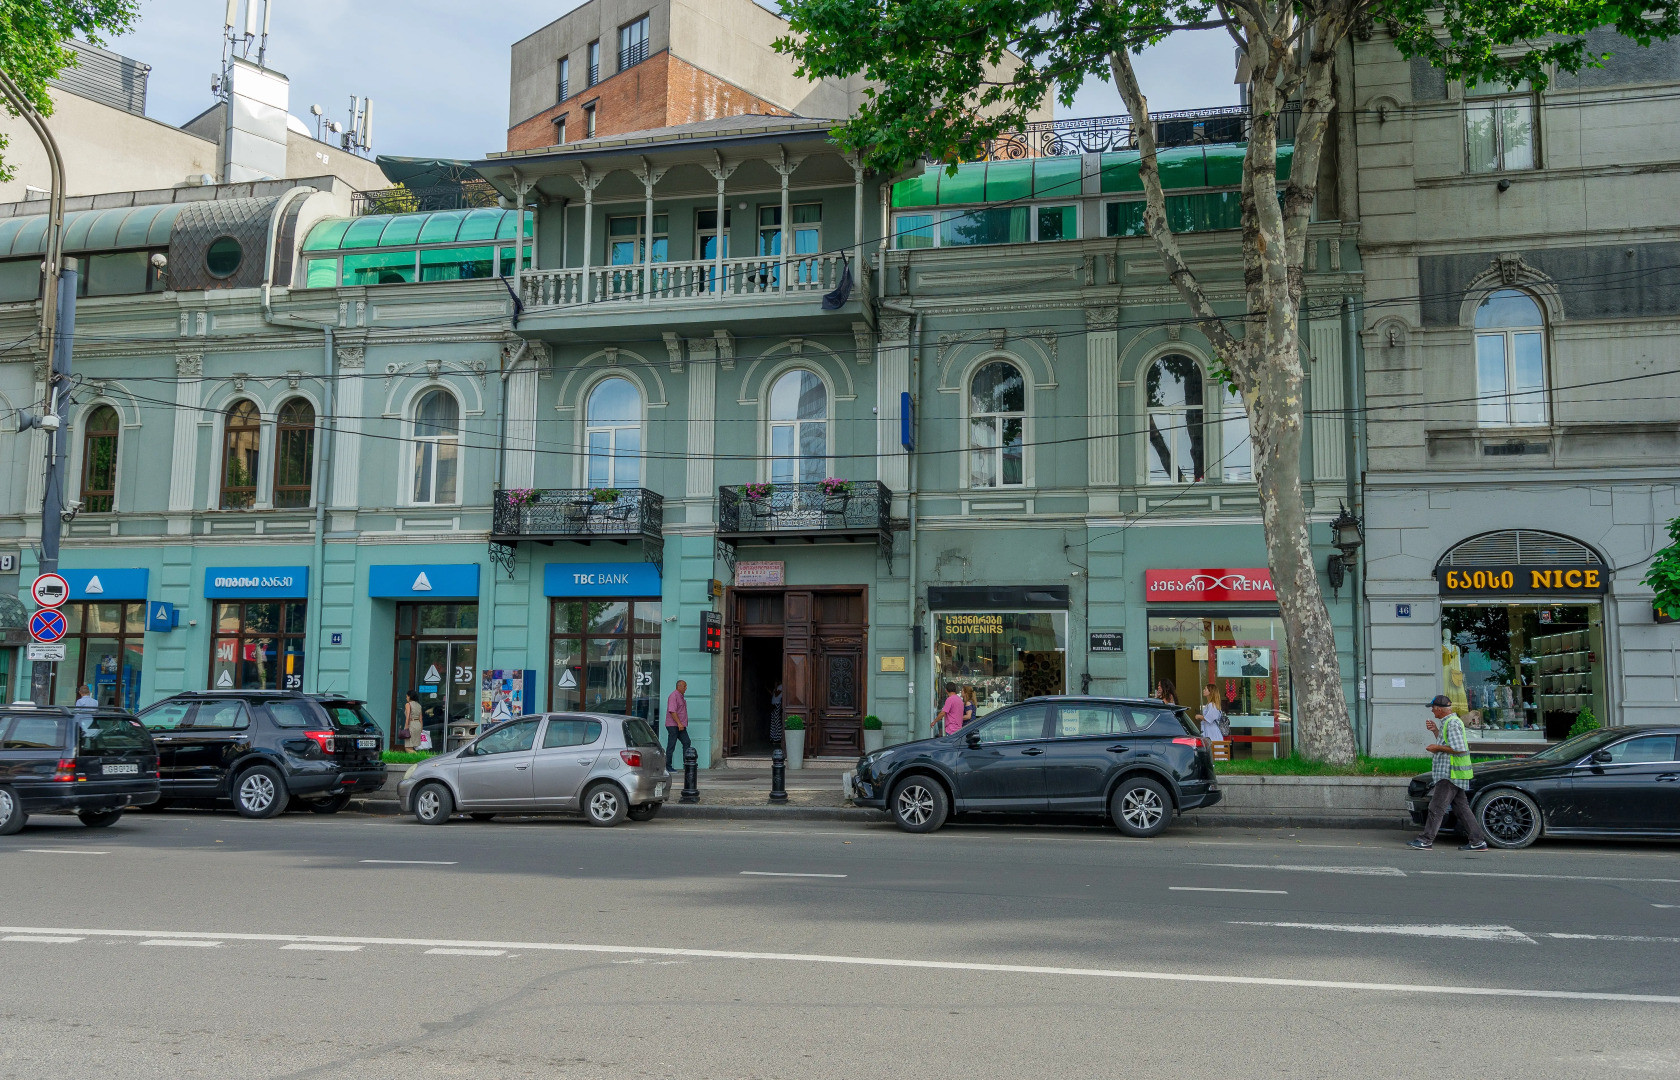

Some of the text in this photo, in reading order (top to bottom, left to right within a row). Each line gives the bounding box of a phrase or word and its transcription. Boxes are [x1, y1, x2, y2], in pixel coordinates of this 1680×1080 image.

[214, 576, 293, 588] თიბისი ბანკი
[573, 573, 629, 585] TBC BANK
[1150, 579, 1205, 592] კენარი
[1446, 570, 1514, 590] ნაისი
[1529, 569, 1601, 589] NICE
[1398, 606, 1410, 615] 46
[945, 615, 1002, 625] სუვენირები
[945, 625, 1003, 634] SOUVENIRS
[455, 666, 473, 682] 25
[636, 672, 653, 686] 25
[286, 674, 301, 688] 25
